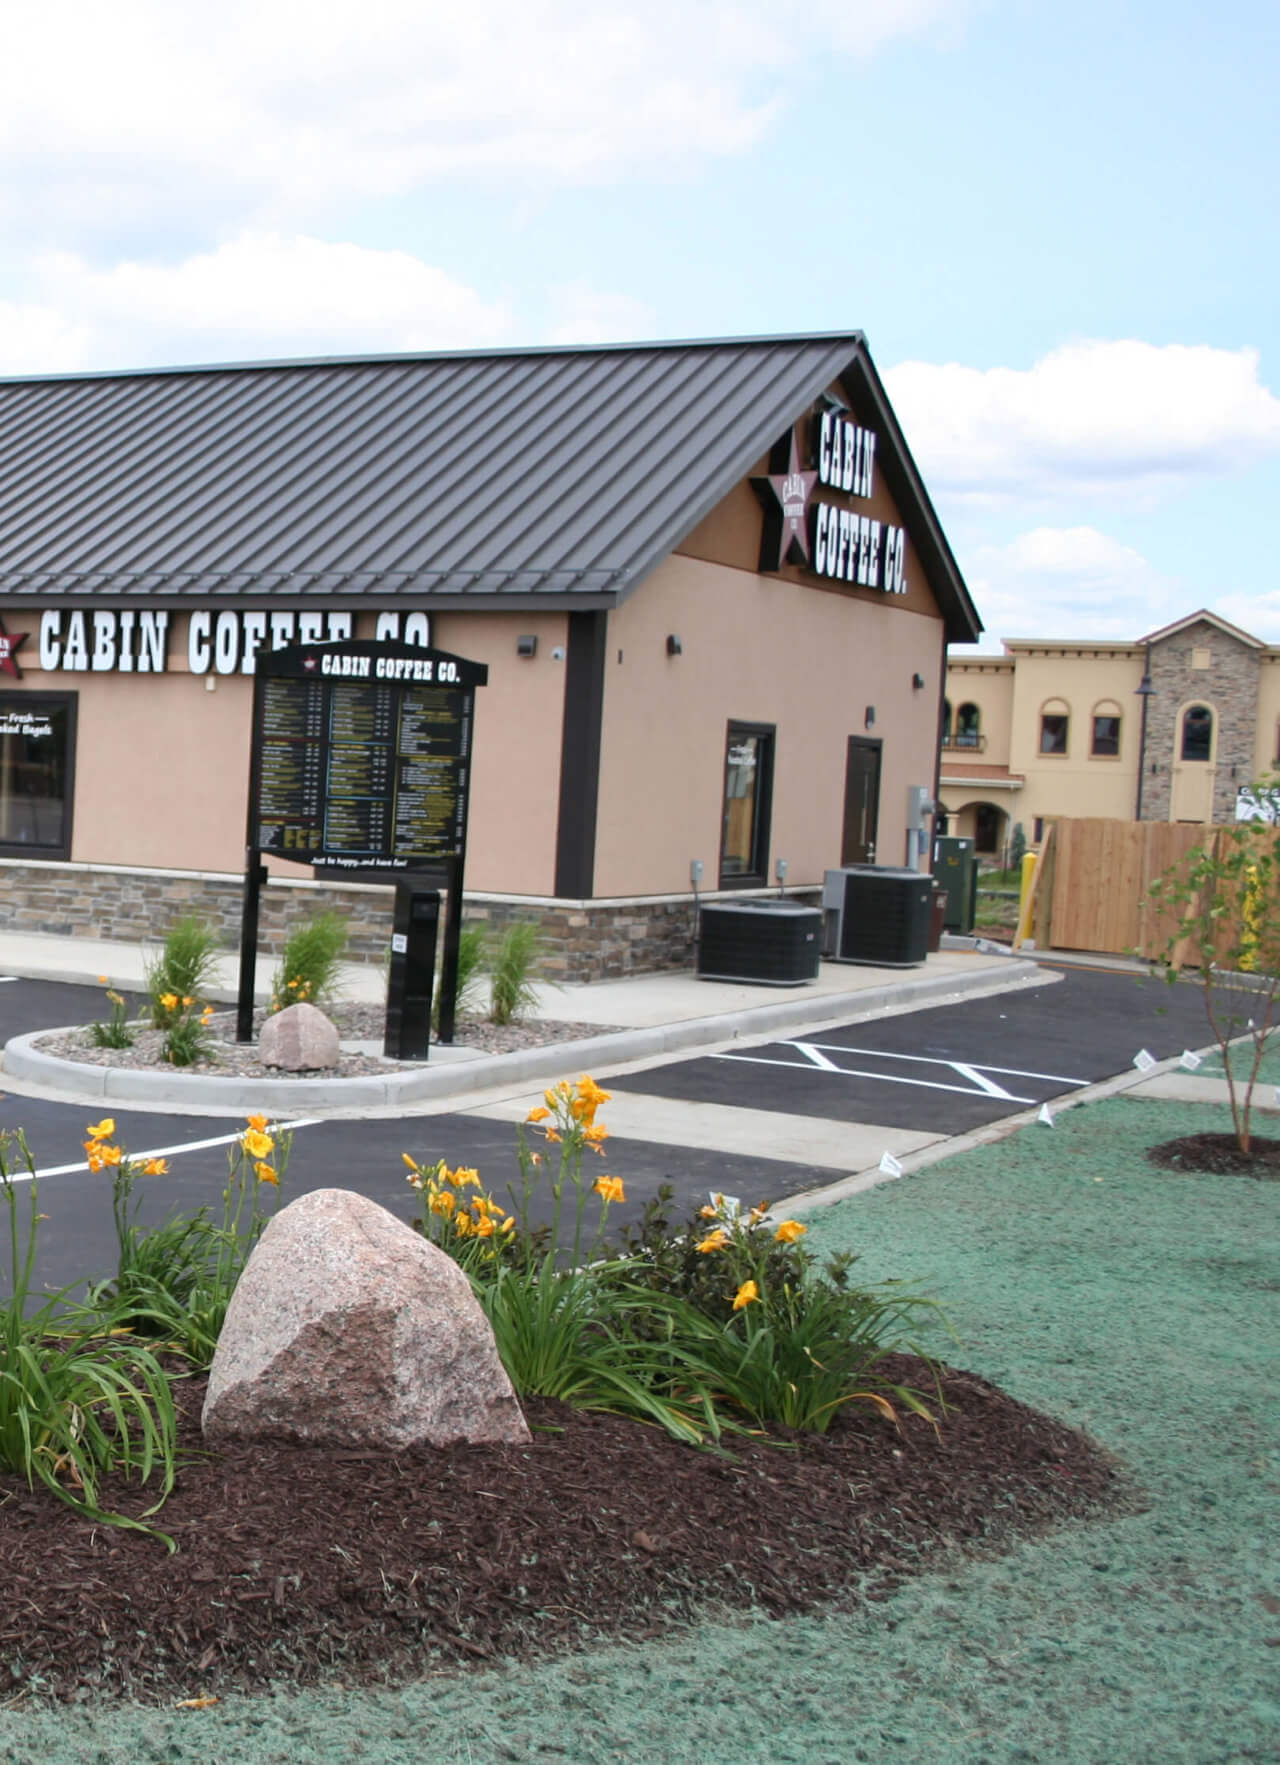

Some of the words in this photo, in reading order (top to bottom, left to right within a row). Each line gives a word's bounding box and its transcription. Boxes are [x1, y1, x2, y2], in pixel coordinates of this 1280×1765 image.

[820, 412, 876, 499] CABIN
[815, 502, 881, 587] COFFEE
[884, 525, 907, 594] CO.
[40, 610, 167, 672] CABIN
[321, 654, 370, 676] CABIN
[376, 657, 432, 682] COFFEE
[437, 661, 461, 683] CO.
[9, 713, 34, 723] Fresh
[22, 724, 52, 738] Bagels
